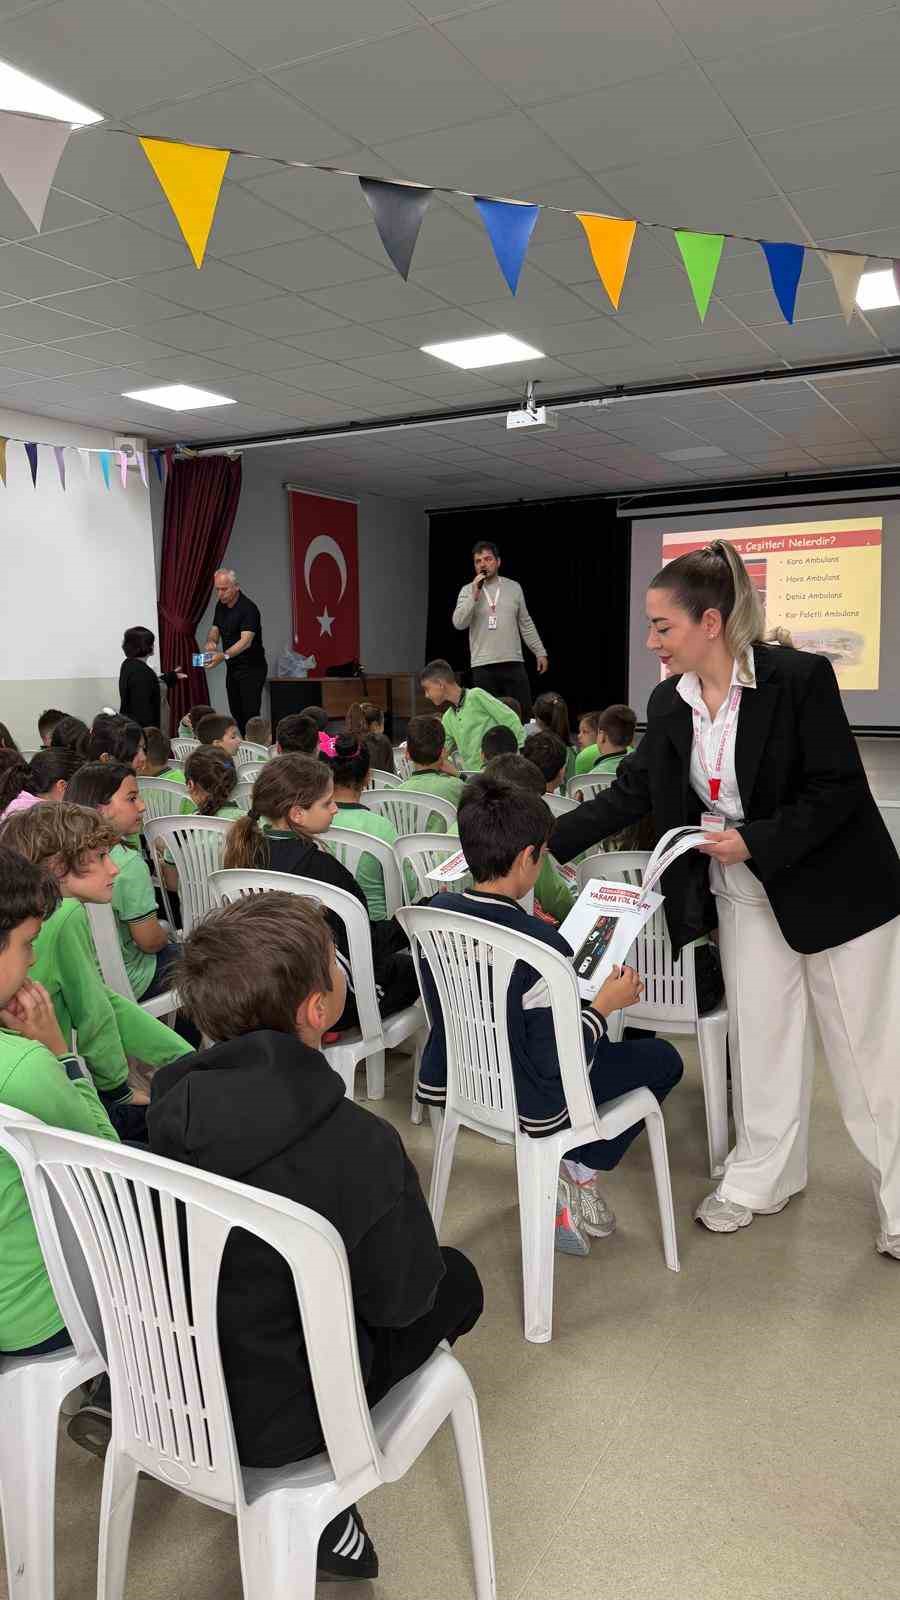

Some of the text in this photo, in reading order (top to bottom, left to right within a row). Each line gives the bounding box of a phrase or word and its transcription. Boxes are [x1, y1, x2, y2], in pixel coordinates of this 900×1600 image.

[788, 535, 836, 548] Nelerdir?
[786, 556, 840, 565] Kara Ambulans
[806, 574, 841, 582] Ambulans
[807, 591, 843, 600] Ambulans
[824, 609, 860, 617] Ambulans
